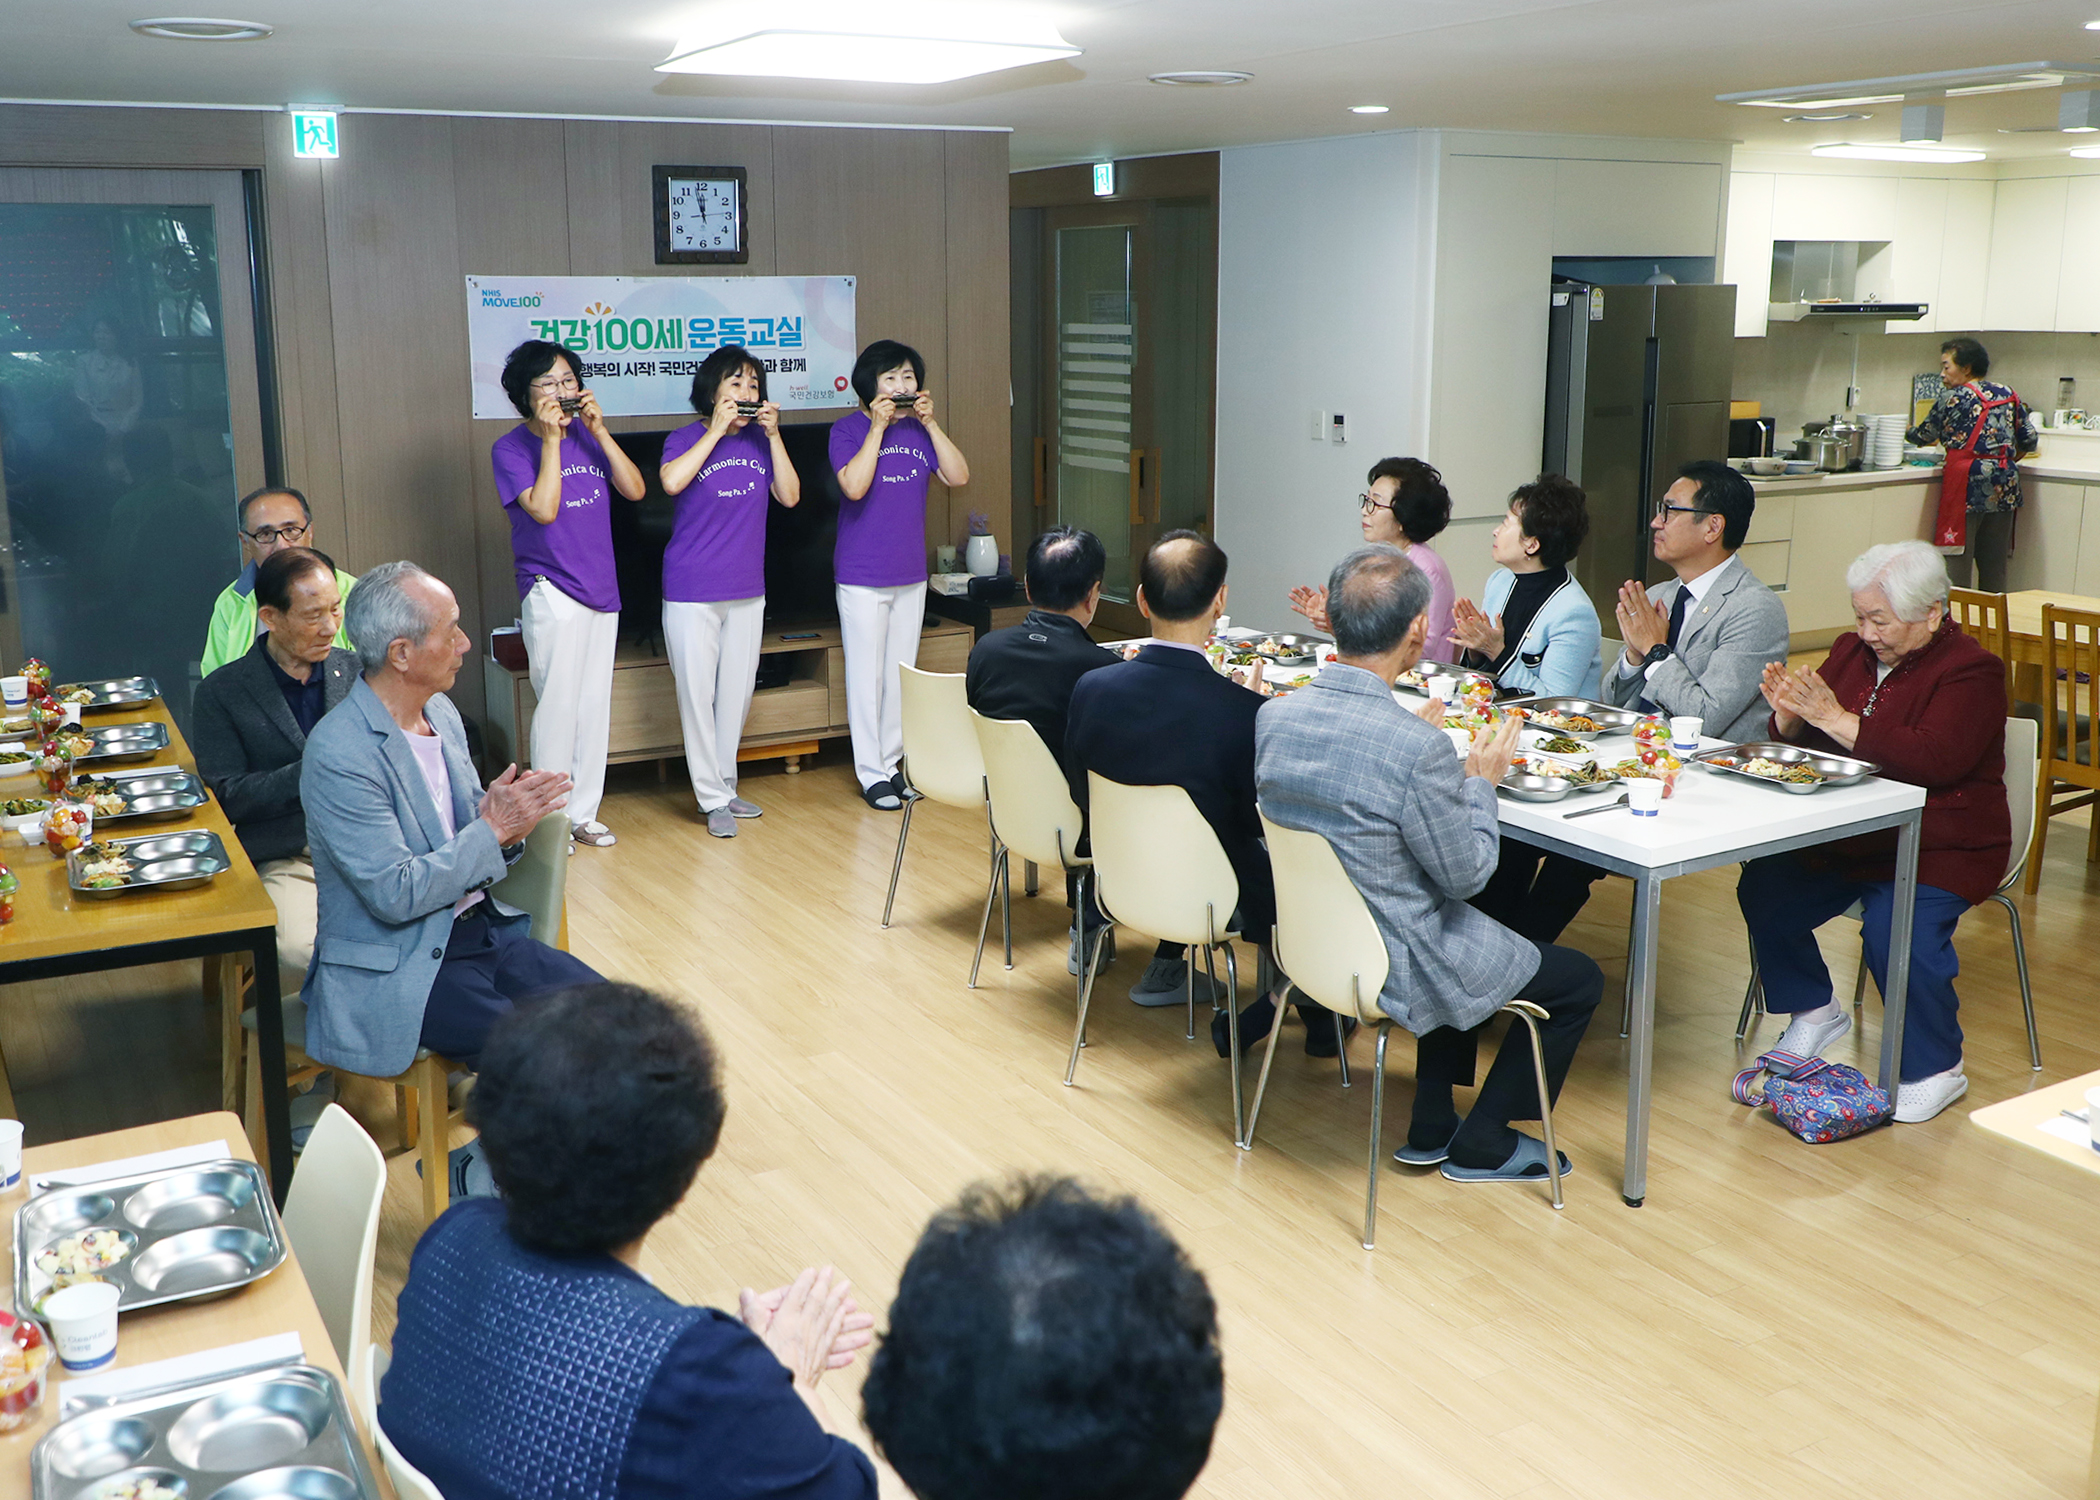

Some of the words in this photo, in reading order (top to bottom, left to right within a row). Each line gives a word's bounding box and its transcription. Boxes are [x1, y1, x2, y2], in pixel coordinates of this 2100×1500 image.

[682, 187, 691, 196] 11
[696, 183, 708, 191] 12
[713, 188, 718, 197] 1
[673, 197, 684, 205] 10
[721, 197, 729, 206] 2
[673, 211, 680, 220] 9
[724, 212, 732, 220] 3
[676, 225, 684, 234] 8
[721, 225, 728, 234] 4
[686, 236, 693, 245] 7
[699, 240, 707, 248] 6
[714, 236, 721, 245] 5
[481, 289, 502, 297] NHIS
[482, 296, 541, 308] MOVE100
[580, 362, 620, 378] 행복의
[624, 361, 656, 377] 시작!
[780, 357, 807, 373] 함께
[789, 389, 835, 400] 국민건강보험
[882, 475, 897, 483] Song
[717, 489, 733, 498] Song
